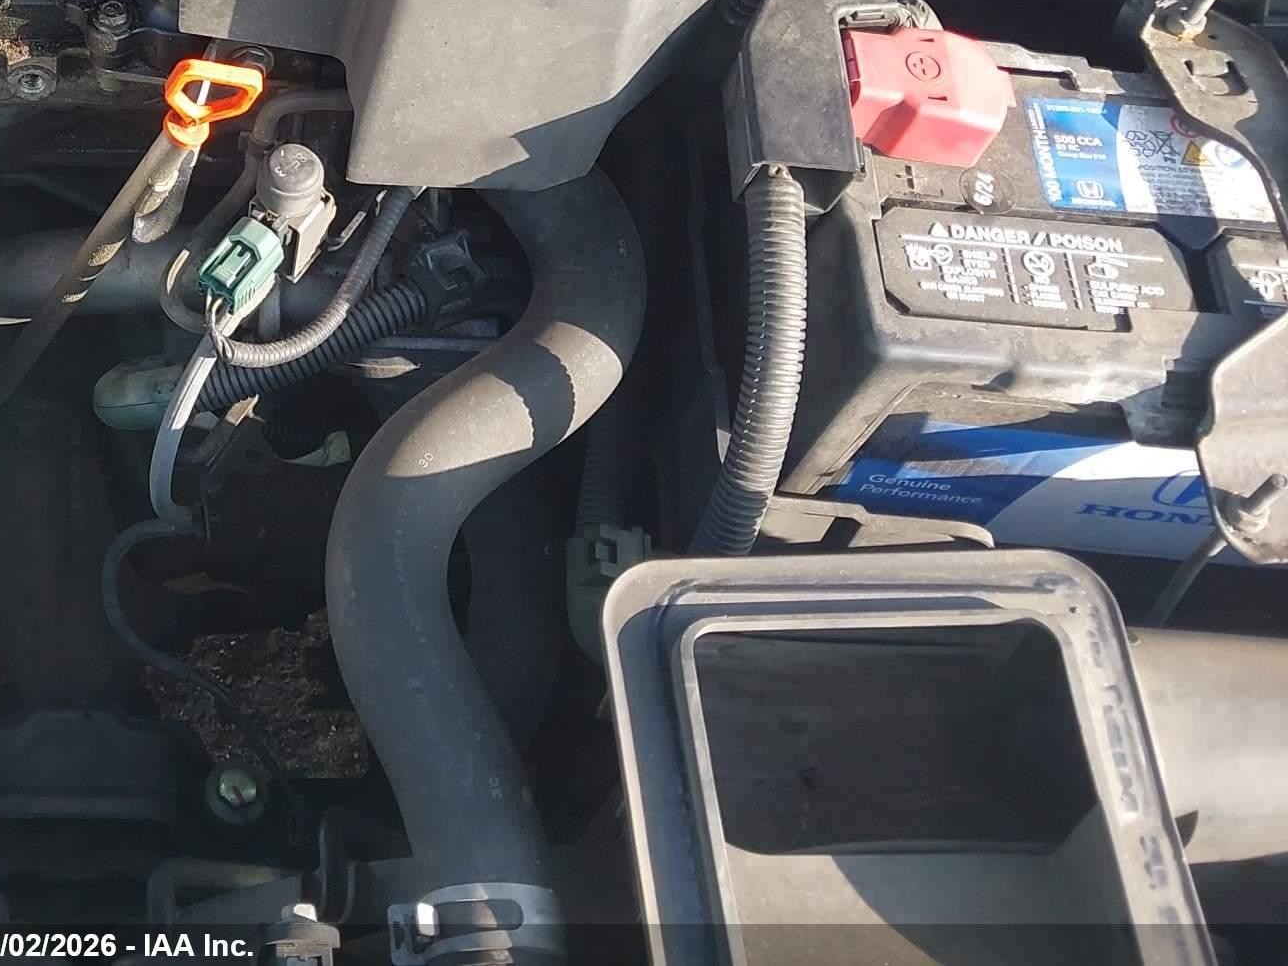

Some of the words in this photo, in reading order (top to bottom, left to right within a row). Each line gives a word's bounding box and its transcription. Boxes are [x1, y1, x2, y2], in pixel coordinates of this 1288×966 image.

[951, 224, 1031, 245] DANGER
[1049, 232, 1123, 253] POISON
[868, 473, 953, 491] Genuine
[859, 483, 984, 504] Performance
[1075, 503, 1216, 527] HON
